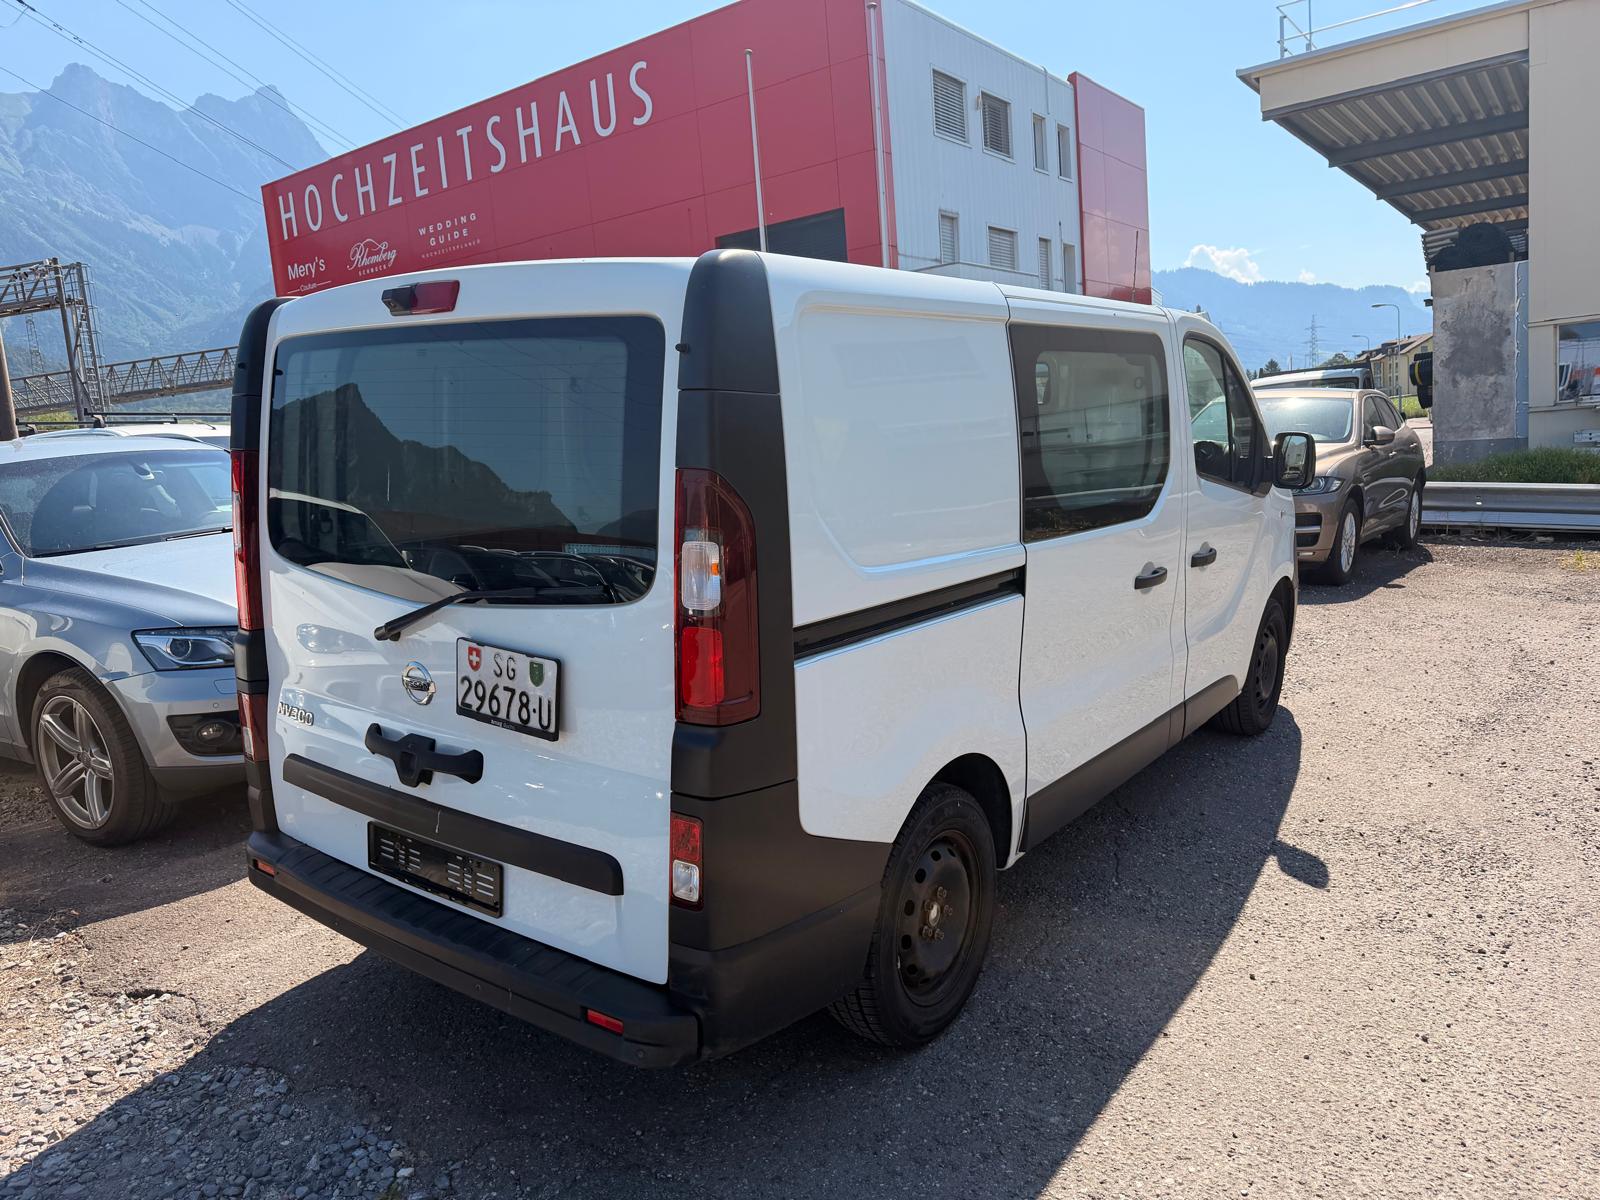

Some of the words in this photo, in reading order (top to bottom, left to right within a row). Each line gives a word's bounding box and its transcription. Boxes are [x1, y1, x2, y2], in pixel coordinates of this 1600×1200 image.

[278, 60, 653, 241] HOCHZEITSHAUS
[418, 212, 477, 236] WEDDING
[429, 228, 469, 246] GUIDE
[346, 238, 397, 271] Rhomberg
[287, 256, 326, 280] Mery's
[493, 653, 516, 681] SG
[278, 701, 315, 726] NV300
